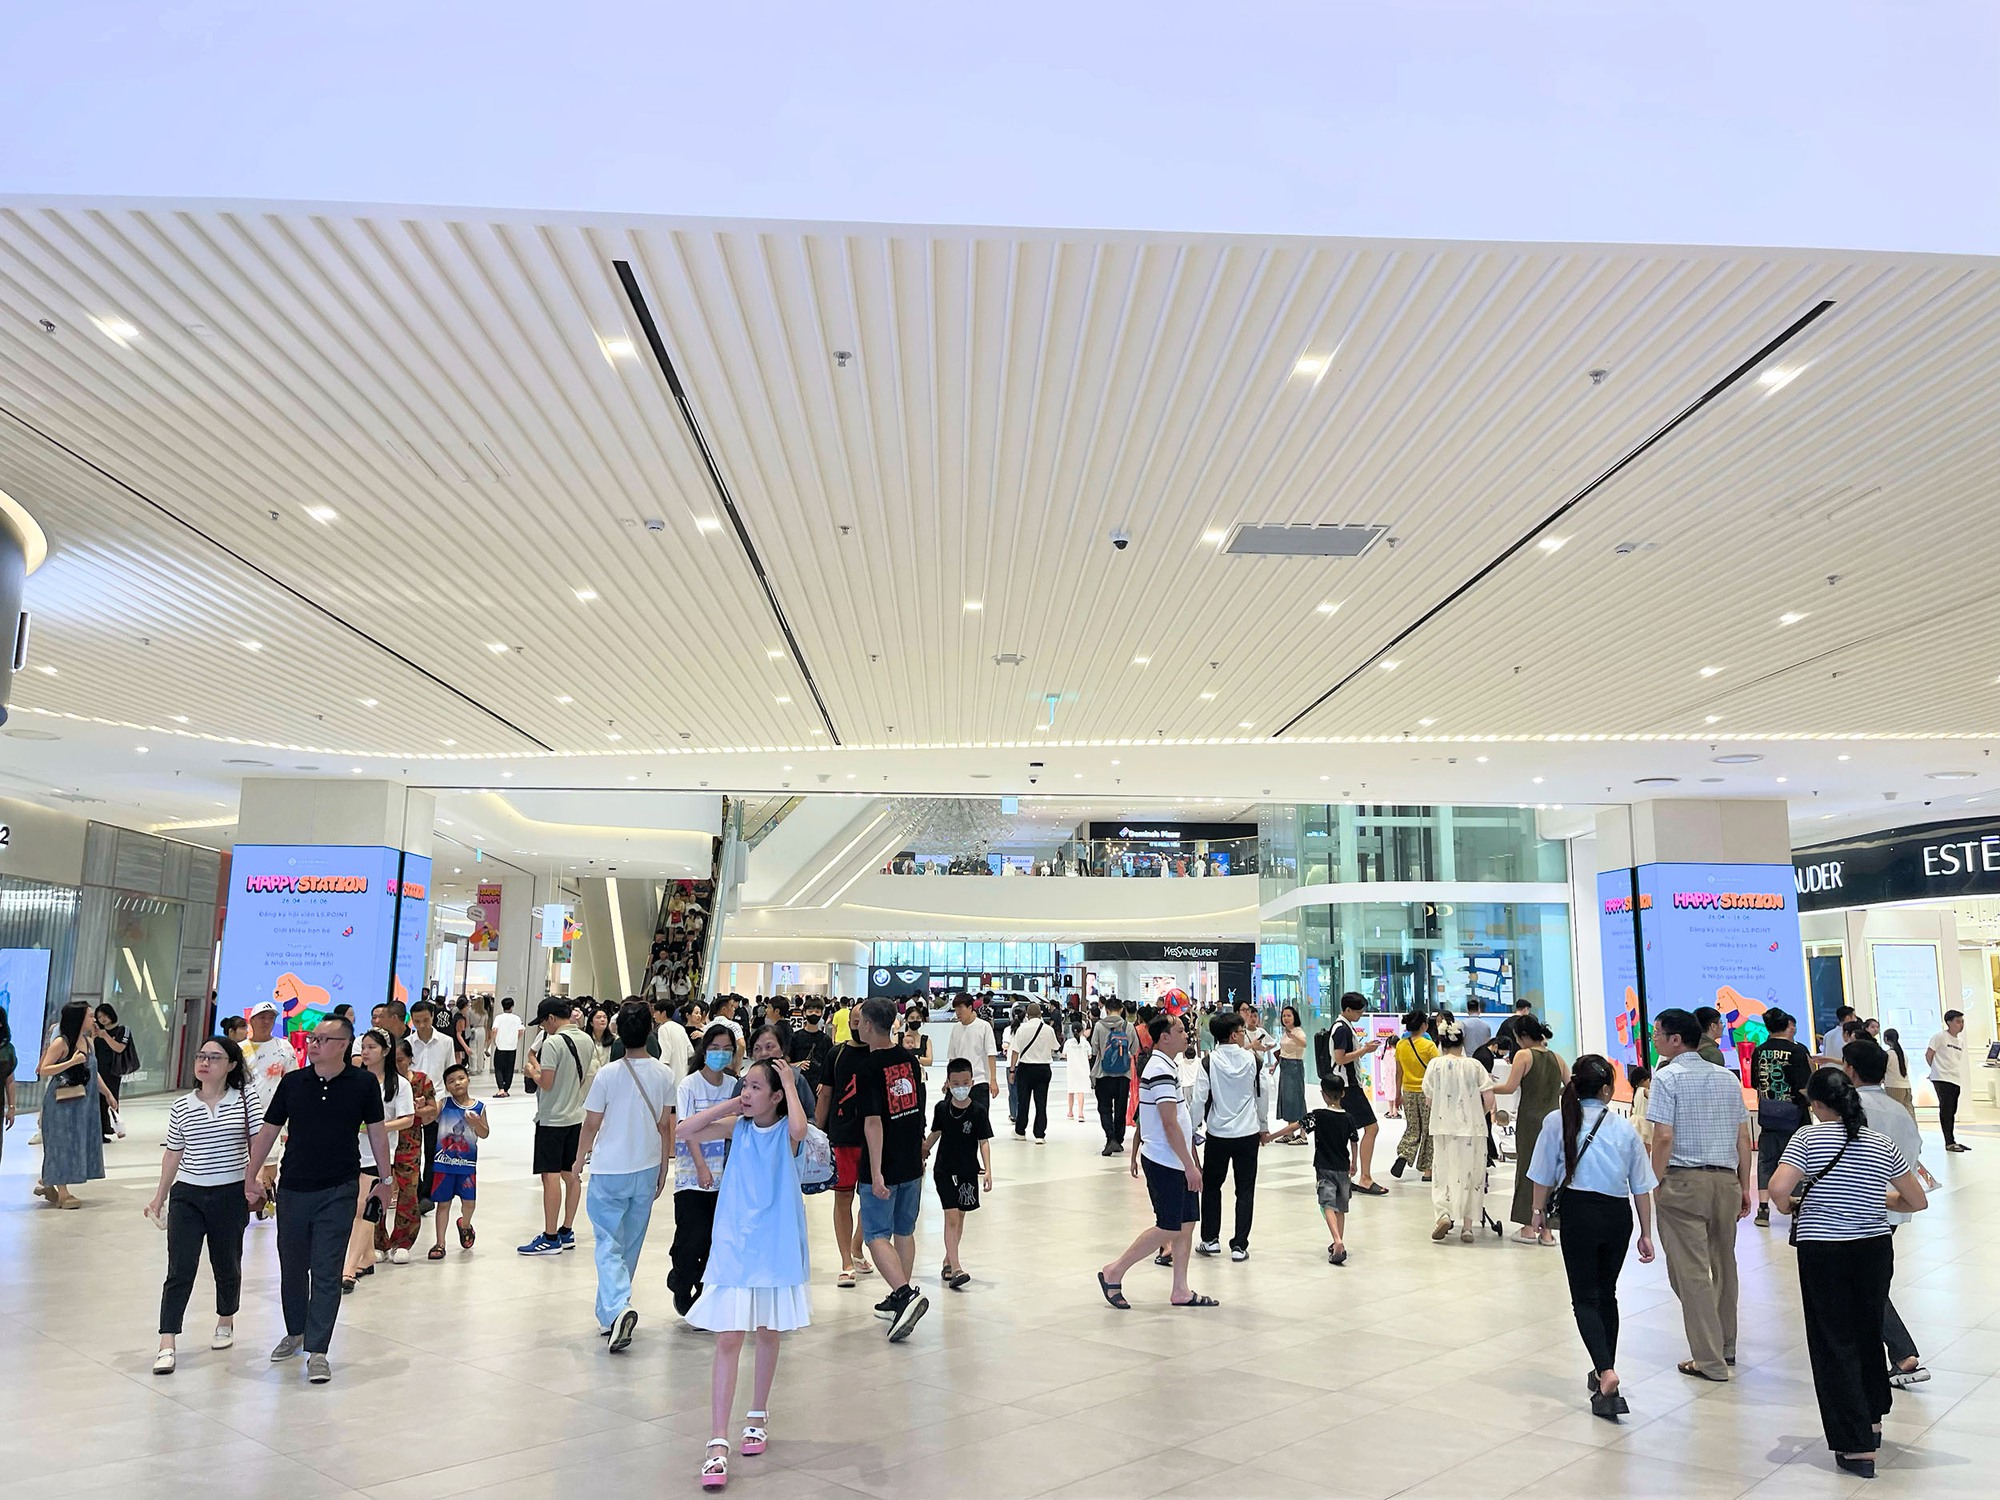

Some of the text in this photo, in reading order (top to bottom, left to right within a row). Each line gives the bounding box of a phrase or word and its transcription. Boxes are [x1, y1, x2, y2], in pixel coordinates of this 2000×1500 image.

[246, 874, 299, 893] HAPPY
[297, 875, 368, 893] STATION
[1673, 892, 1785, 910] HAPPY STATION
[791, 1017, 803, 1028] 25
